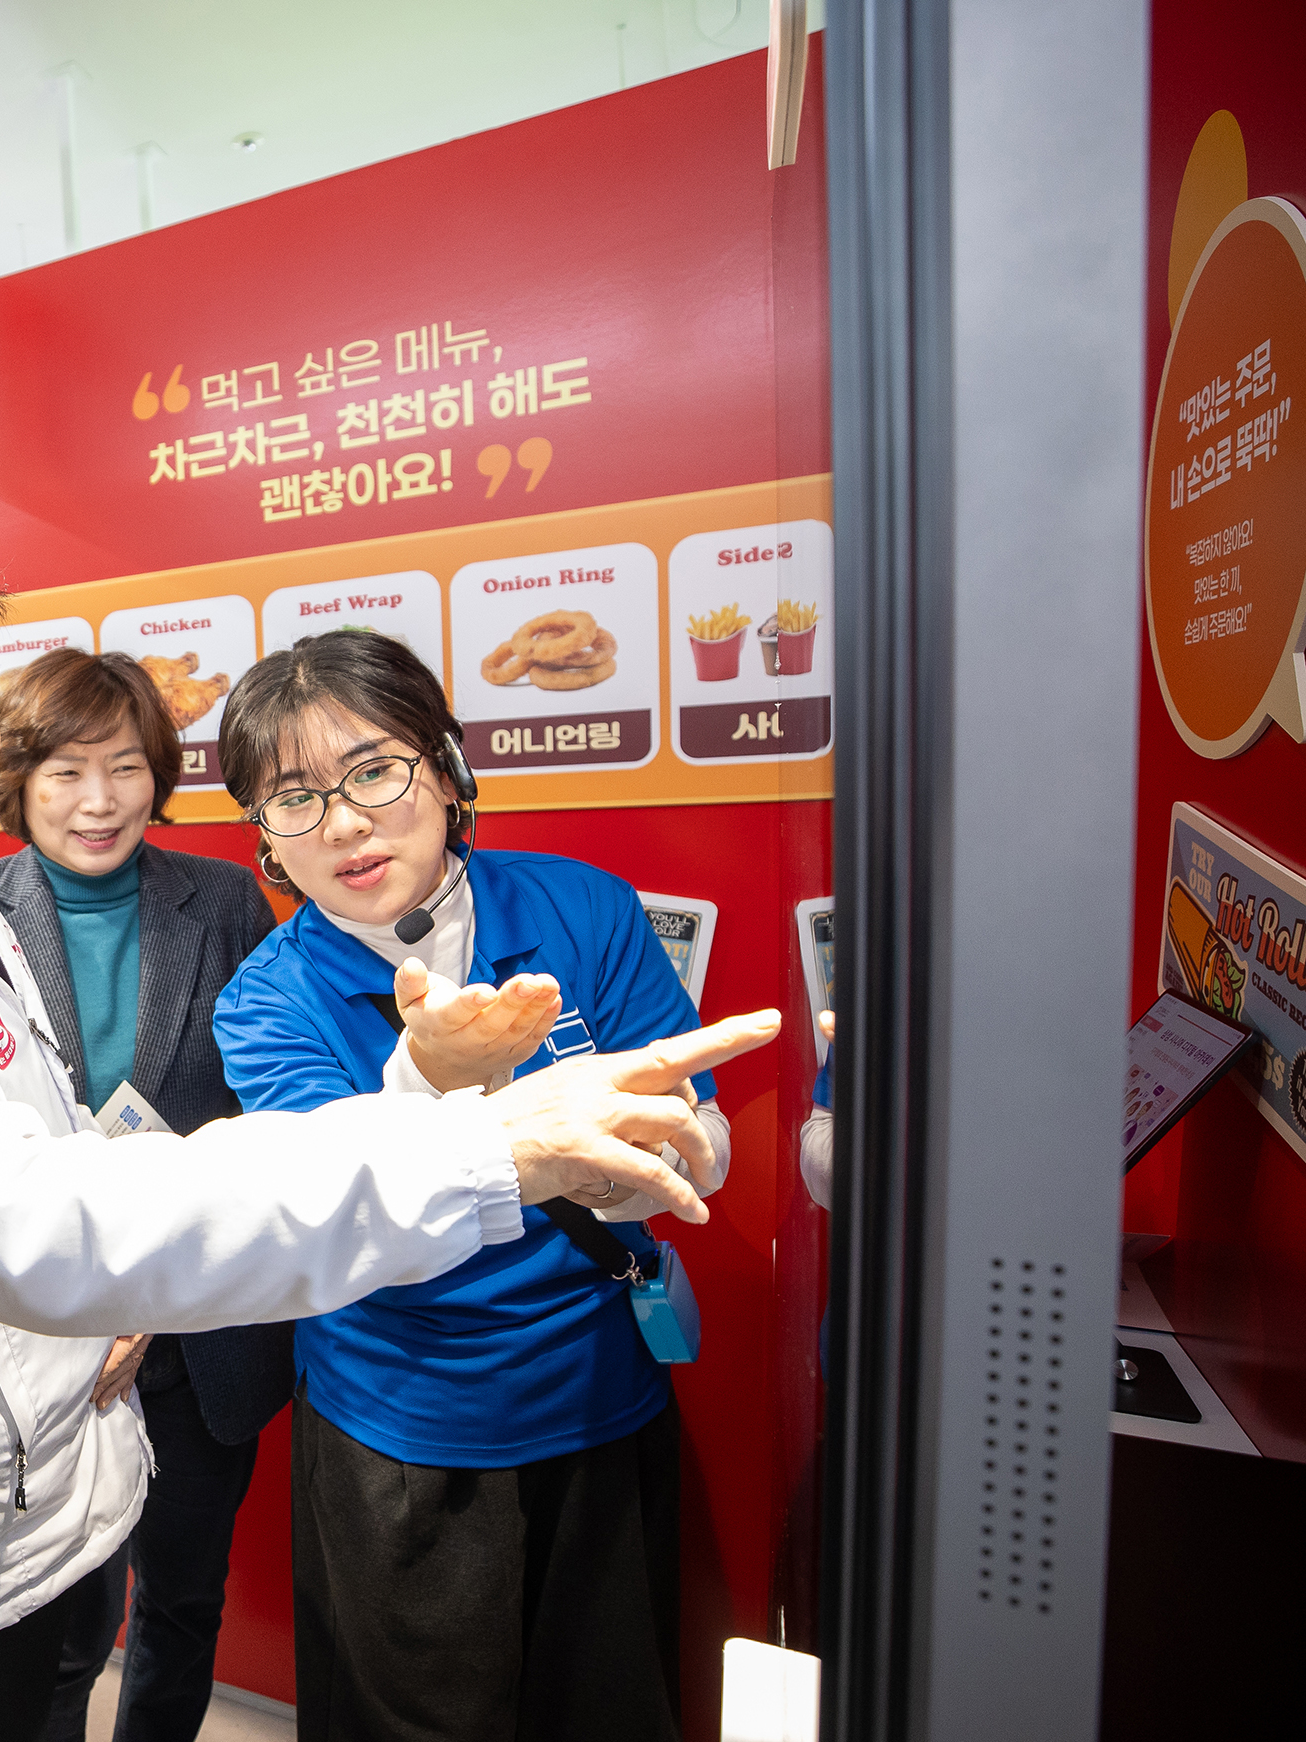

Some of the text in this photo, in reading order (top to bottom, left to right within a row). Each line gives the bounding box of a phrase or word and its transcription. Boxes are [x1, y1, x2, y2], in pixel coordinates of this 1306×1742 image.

[201, 320, 503, 412] 먹고 싶은 메뉴,
[1235, 338, 1277, 408] 주문,
[149, 356, 593, 485] 차근차근, 천천히 해도
[260, 448, 454, 522] 괜찮아요!
[1170, 462, 1185, 510] 내
[1187, 435, 1232, 503] 손으로
[1223, 518, 1254, 556] 않아요!
[717, 546, 774, 567] Side
[483, 566, 616, 594] Onion Ring
[1194, 574, 1219, 605] 맛있는
[1220, 568, 1230, 597] 한
[299, 591, 403, 617] Beef Wrap
[140, 616, 212, 636] Chicken
[1184, 615, 1209, 645] 손쉽게
[490, 720, 622, 756] 어니언링
[1191, 841, 1215, 877] TRY
[1188, 867, 1213, 903] OUR
[649, 912, 691, 925] YOU'LL
[654, 920, 685, 931] LOVE
[1215, 872, 1256, 952] Hot
[655, 927, 681, 937] OUR
[1251, 971, 1288, 1013] CLASSIC
